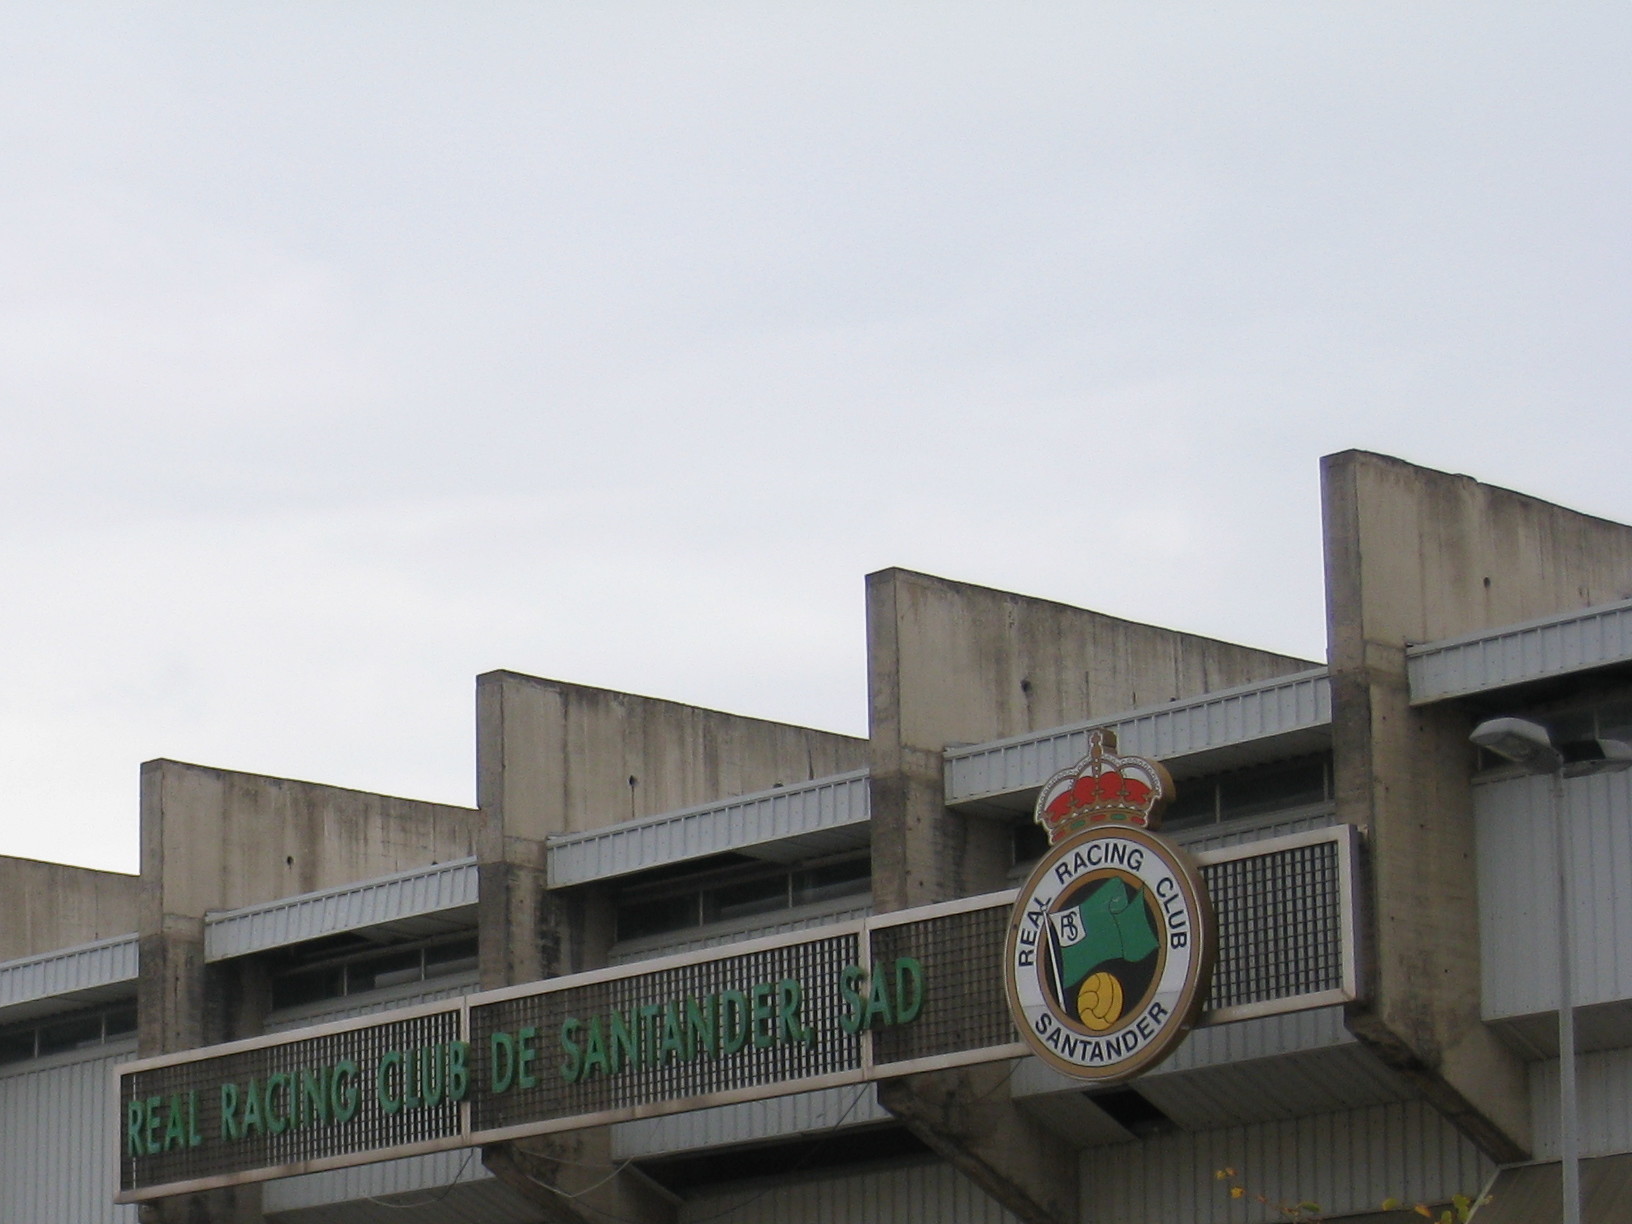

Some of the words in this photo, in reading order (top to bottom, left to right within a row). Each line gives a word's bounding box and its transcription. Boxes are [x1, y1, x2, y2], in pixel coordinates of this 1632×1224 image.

[1019, 896, 1051, 967] REAL
[1055, 843, 1144, 884] RACING
[1157, 877, 1188, 950] CLUB
[127, 1091, 202, 1157] REAL
[220, 1059, 359, 1141] RACING
[376, 1040, 471, 1114] CLUB
[489, 1026, 538, 1094] DE
[839, 956, 926, 1035] SAD
[1035, 1000, 1168, 1063] SANTANDER
